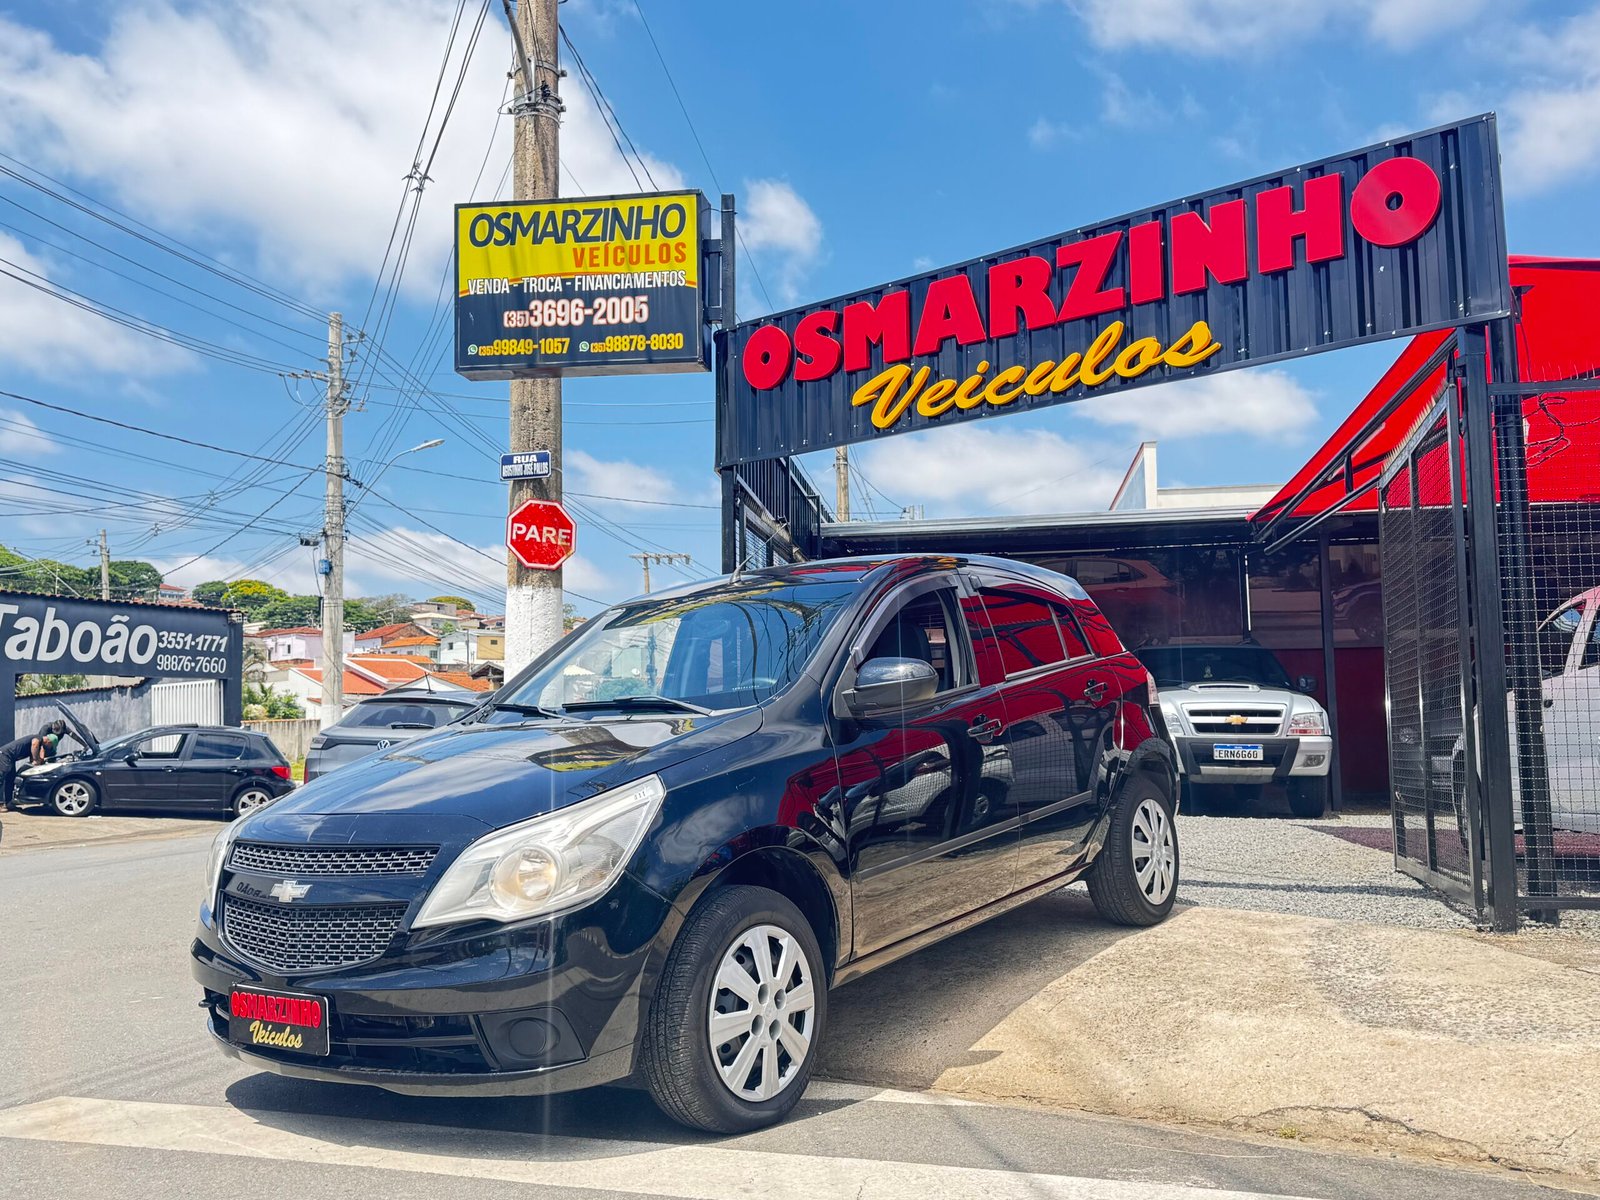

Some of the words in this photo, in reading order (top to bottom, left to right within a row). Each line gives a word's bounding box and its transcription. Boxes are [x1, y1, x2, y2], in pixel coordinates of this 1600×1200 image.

[469, 203, 686, 247] OSMARZINHO
[572, 241, 687, 268] VEÍCULOS
[468, 278, 510, 295] VENDA
[521, 276, 563, 294] TROCA
[574, 270, 686, 292] FINANCIAMENTOS
[743, 156, 1442, 390] OSMARZINHO
[513, 454, 537, 463] RUA
[512, 523, 571, 546] PARE
[1219, 750, 1258, 758] ERN6G60
[231, 991, 322, 1029] OSMARZINHO
